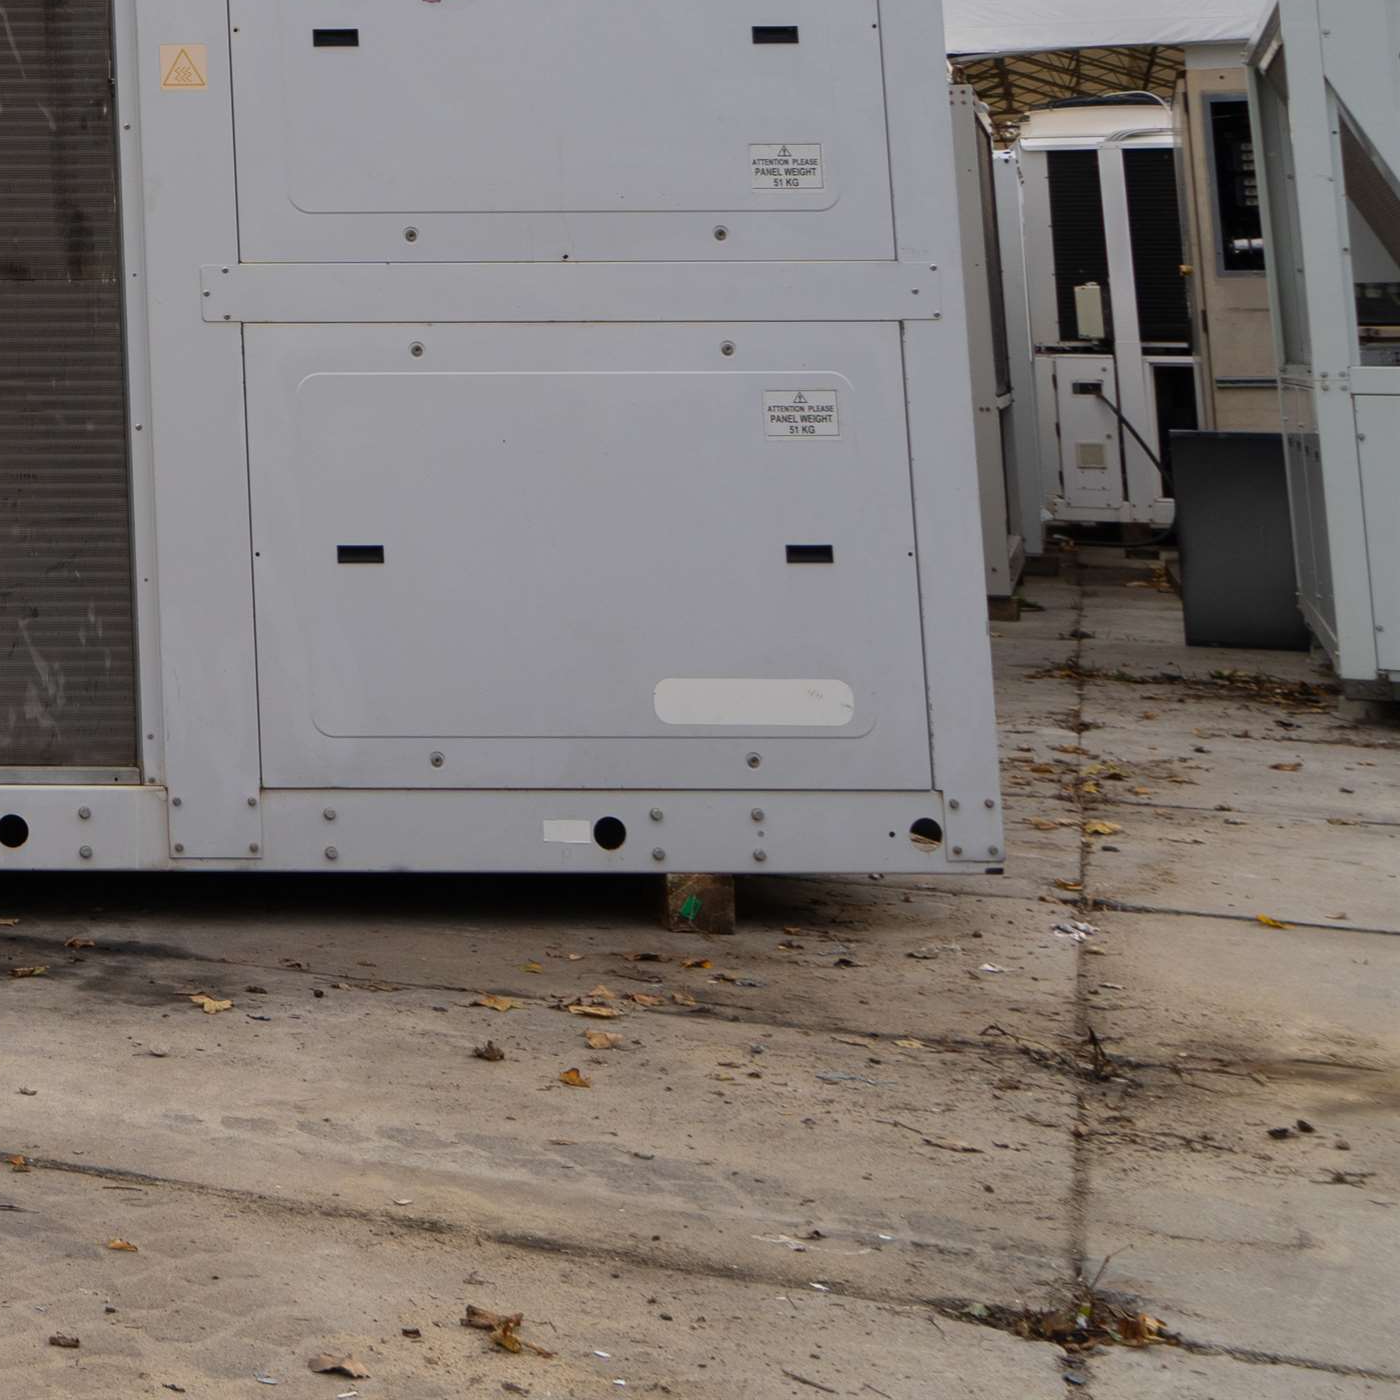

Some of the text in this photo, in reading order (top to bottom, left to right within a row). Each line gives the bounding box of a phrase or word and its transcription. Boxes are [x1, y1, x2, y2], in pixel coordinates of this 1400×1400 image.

[751, 158, 819, 166] ATTENTION PLEASE
[754, 167, 817, 177] PANEL WEIGHT
[785, 178, 800, 187] KG
[770, 414, 833, 424] PANEL WEIGHT
[801, 425, 816, 434] KG
